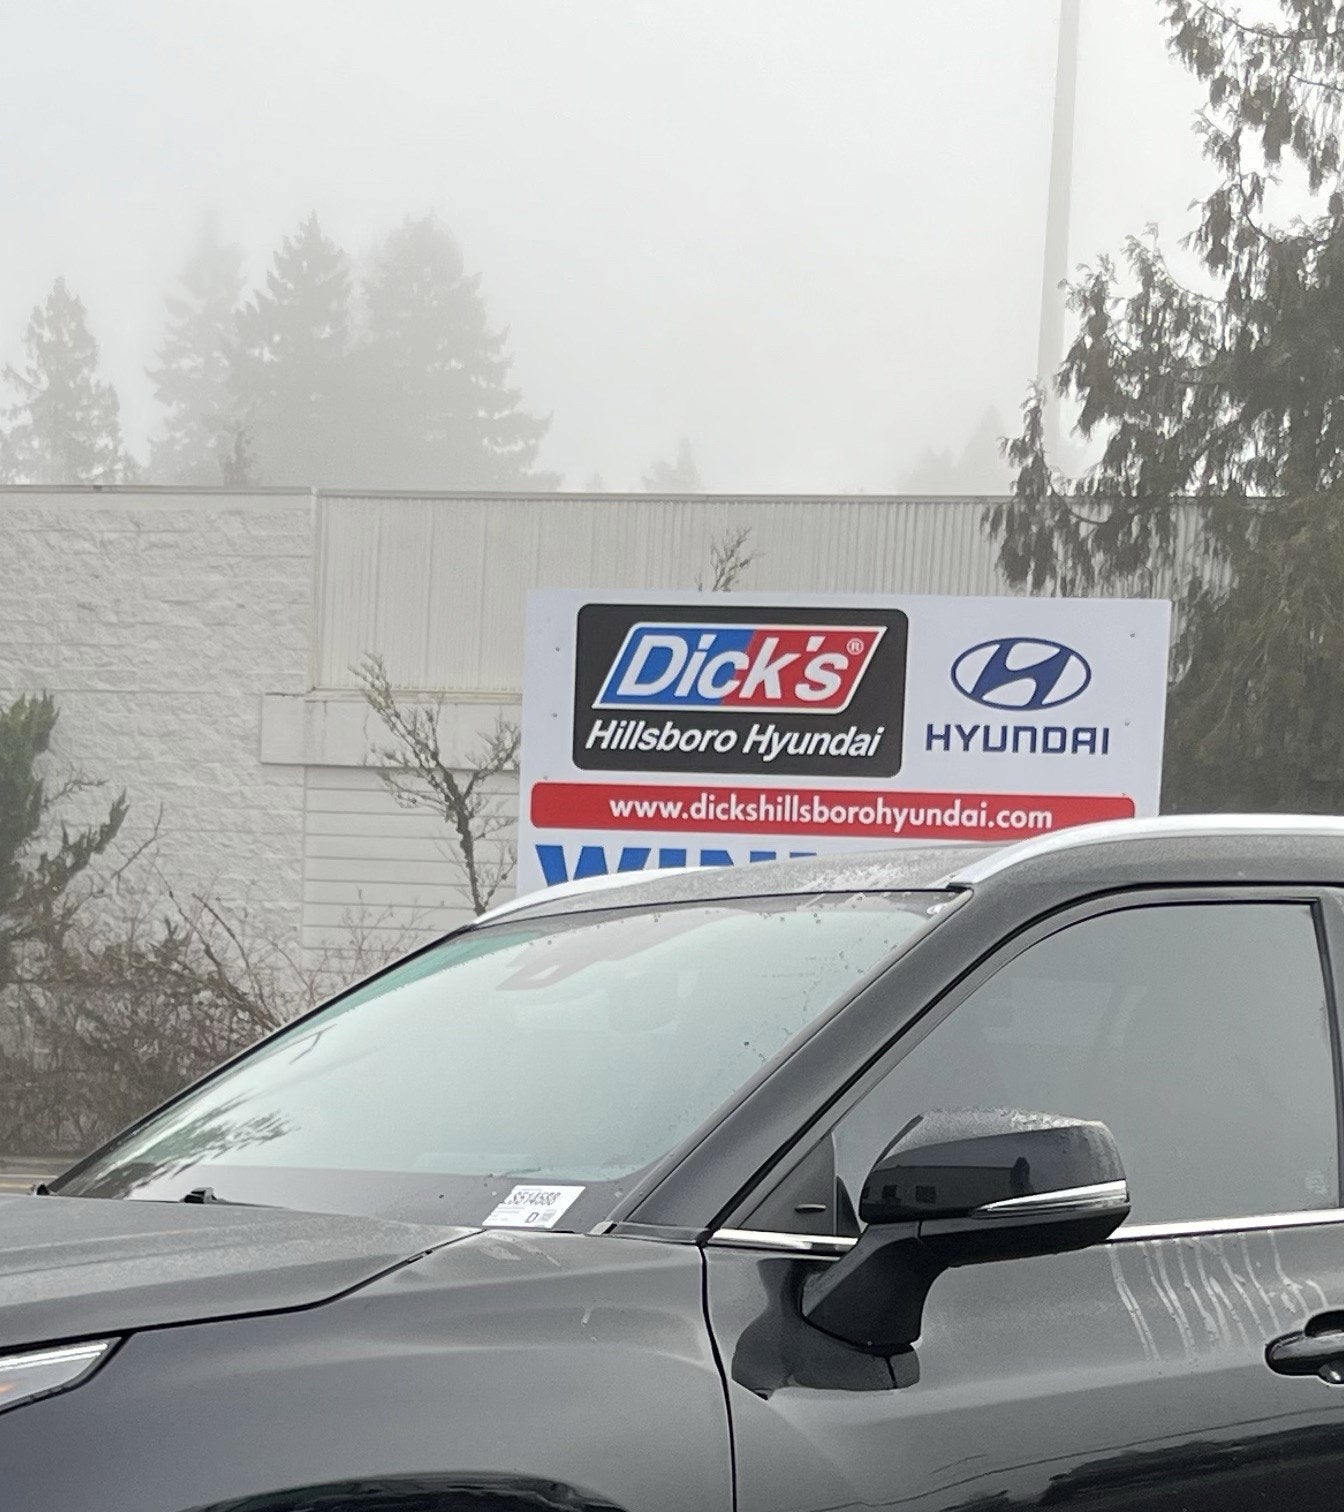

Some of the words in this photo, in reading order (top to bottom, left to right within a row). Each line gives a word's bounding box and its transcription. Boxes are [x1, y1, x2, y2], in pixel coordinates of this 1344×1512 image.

[586, 719, 737, 753] Hillsboro
[743, 724, 884, 762] Hyundai
[925, 723, 1110, 755] HYUNDAI
[609, 794, 1053, 831] www.dickshillsborohyundai.com
